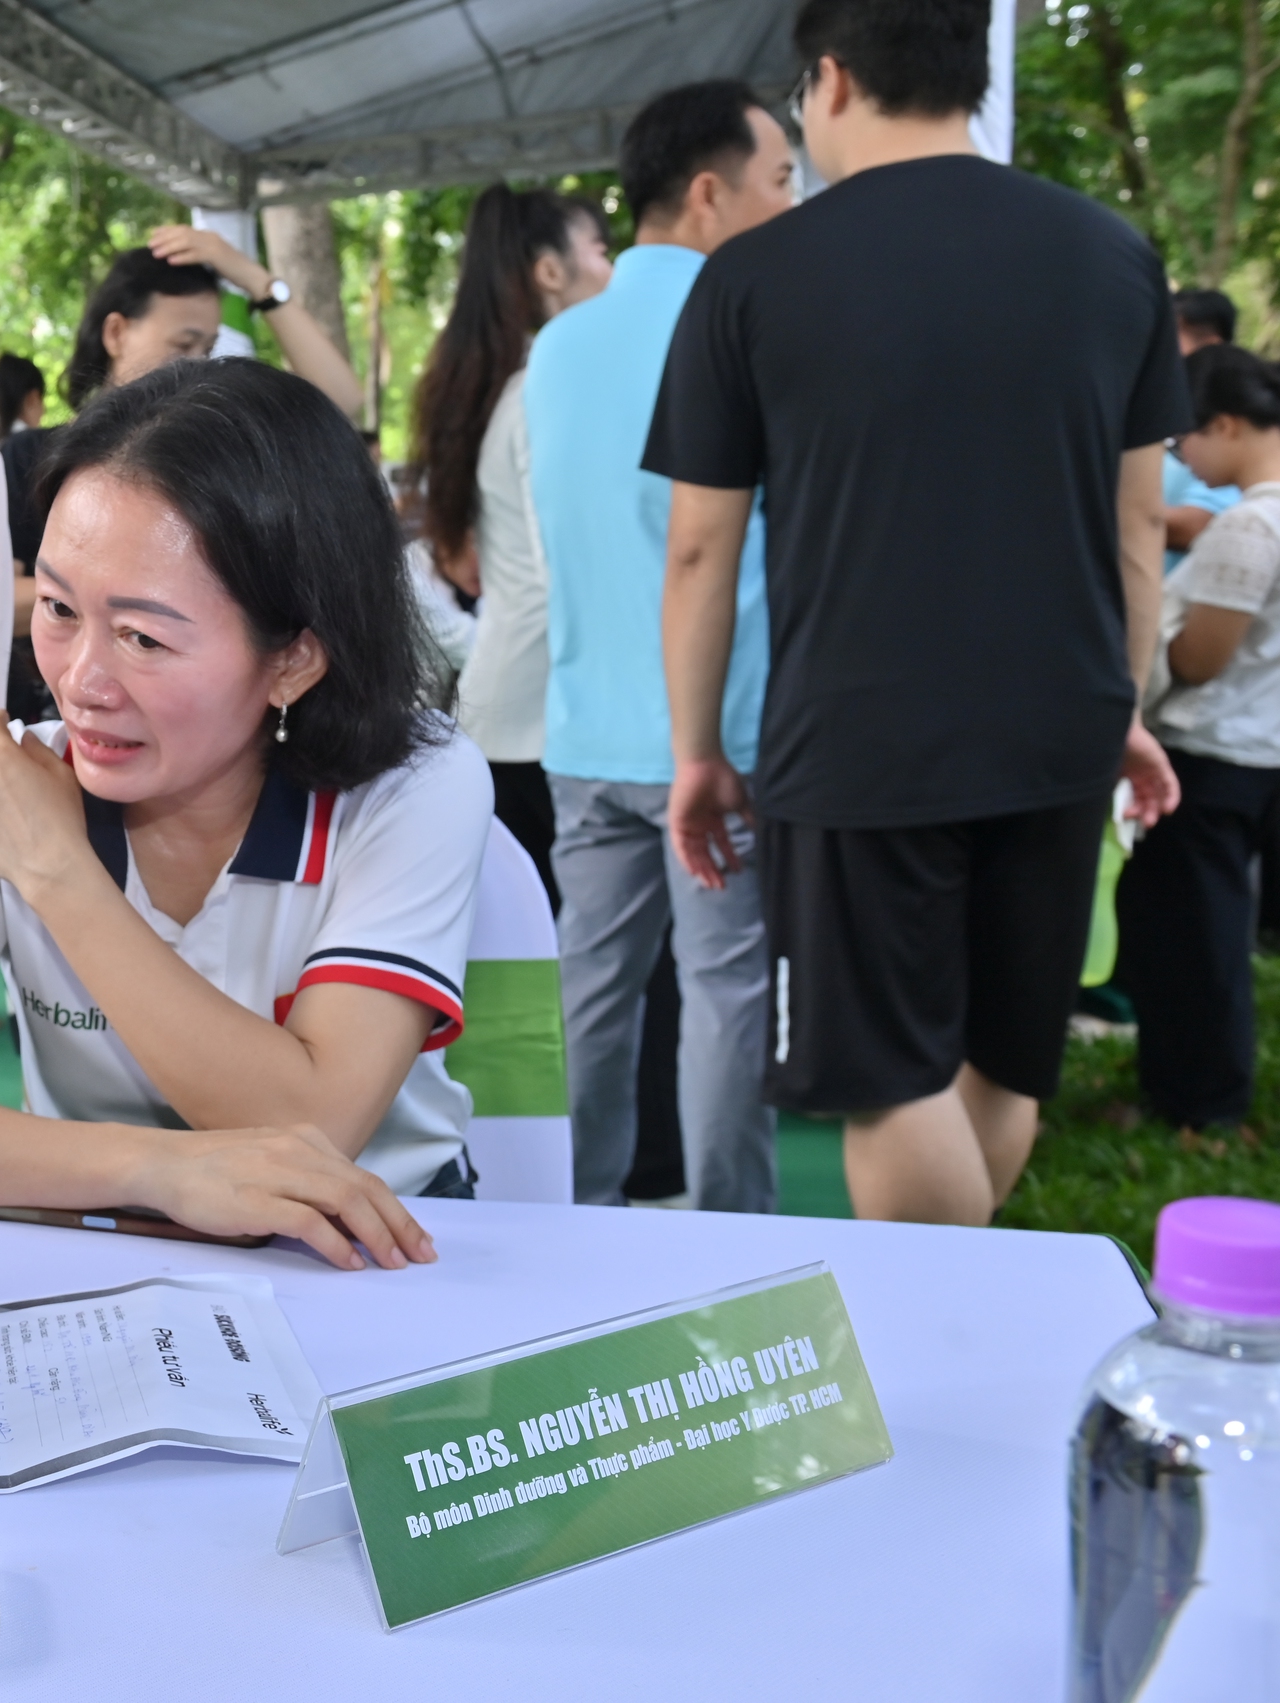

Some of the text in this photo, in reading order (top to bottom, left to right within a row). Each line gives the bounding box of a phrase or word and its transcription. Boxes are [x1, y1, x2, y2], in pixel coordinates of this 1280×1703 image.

[151, 1327, 190, 1387] Phiếu tư vấn
[246, 1392, 281, 1430] Herbalife
[404, 1335, 819, 1492] ThS.BS. NGUYỄN THỊ HỒNG UYÊN
[406, 1512, 432, 1539] Bộ
[433, 1502, 474, 1531] môn
[473, 1487, 514, 1518] Dinh
[515, 1472, 568, 1504] dưỡng
[567, 1463, 589, 1487] và
[587, 1452, 629, 1480] Thực
[629, 1436, 675, 1470] phẩm
[683, 1424, 712, 1450] Đại
[710, 1417, 740, 1442] học
[739, 1410, 751, 1431] Y
[751, 1401, 790, 1428] Dược
[788, 1393, 811, 1416] TP.
[808, 1382, 843, 1410] HCM
